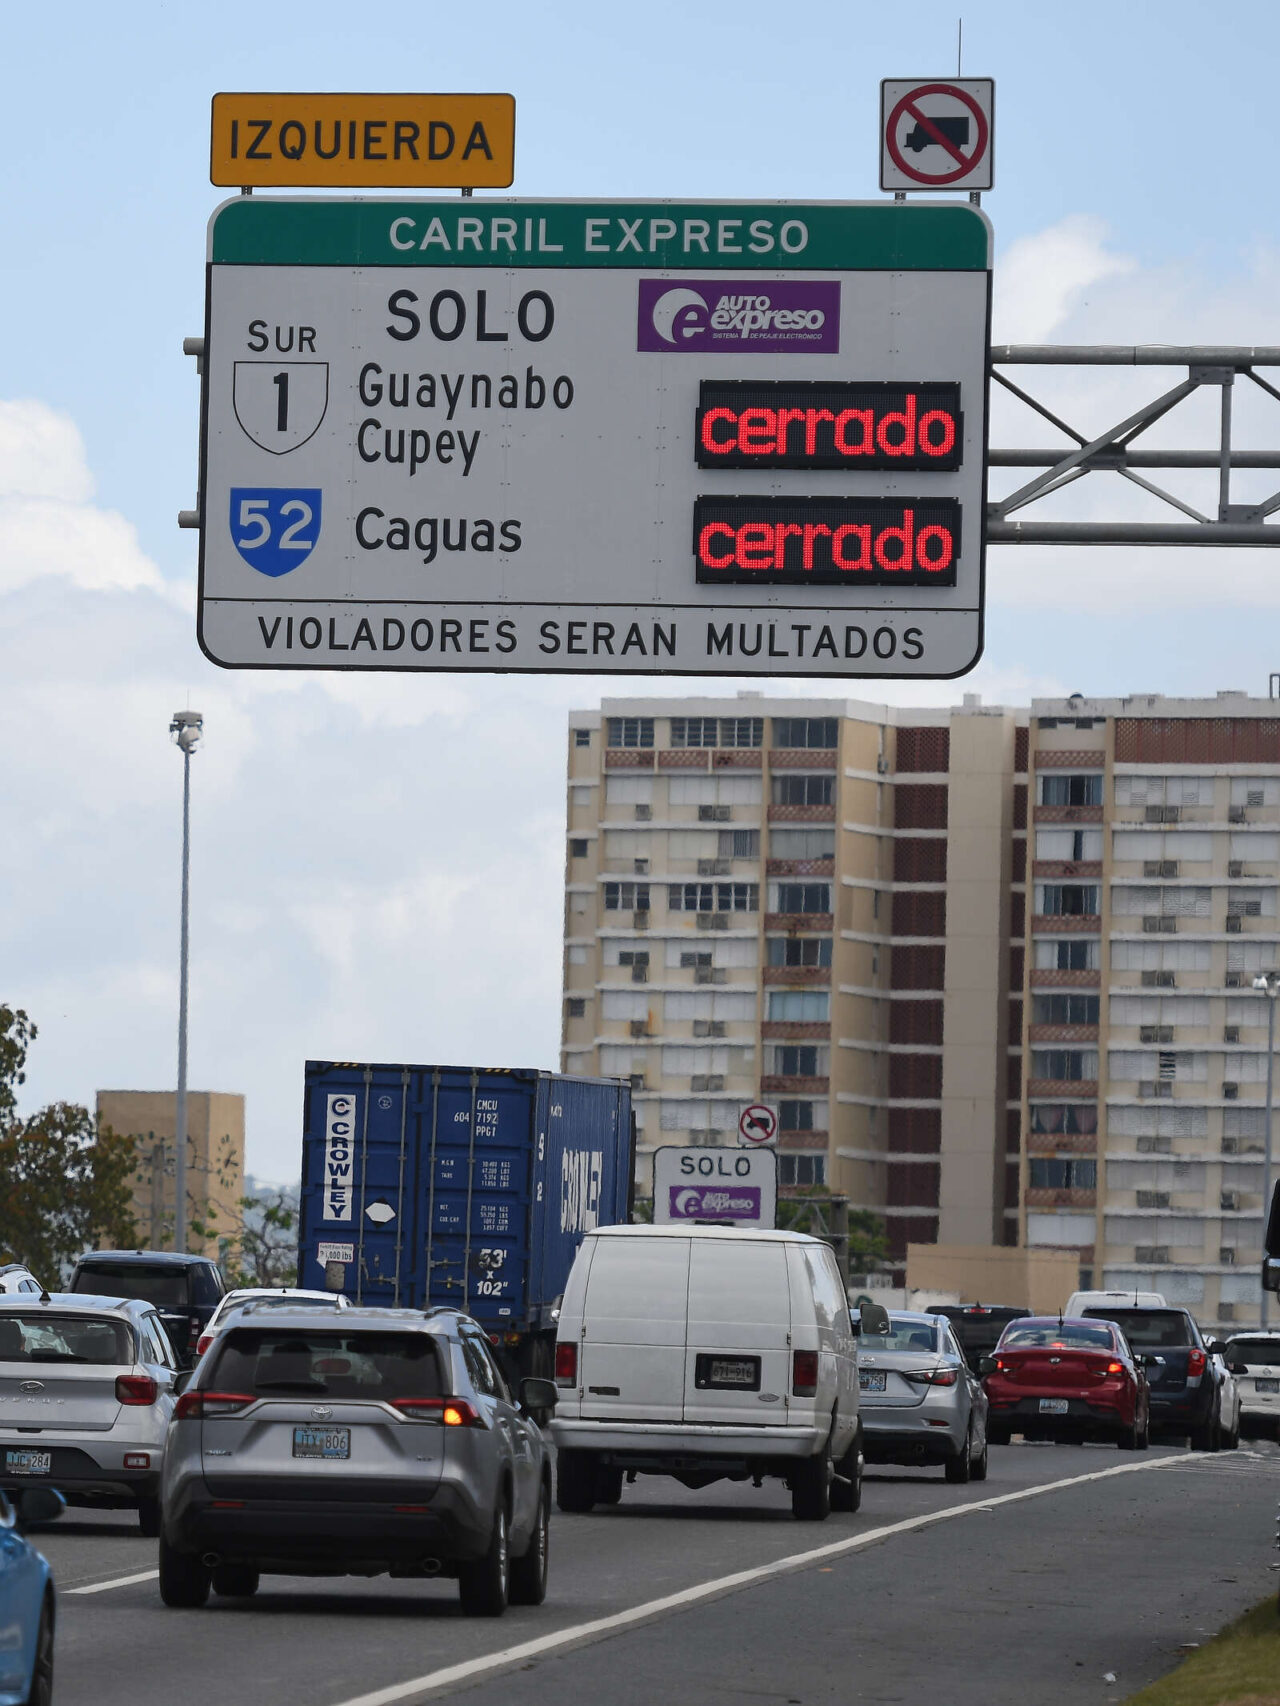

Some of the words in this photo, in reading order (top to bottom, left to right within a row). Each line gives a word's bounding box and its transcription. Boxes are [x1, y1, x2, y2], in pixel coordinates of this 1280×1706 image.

[231, 120, 493, 161] IZQUIERDA
[389, 217, 564, 252] CARRIL
[585, 218, 809, 253] EXPRESO
[387, 290, 555, 342] SOLO
[710, 309, 825, 338] expreso
[716, 295, 771, 310] AUTO
[273, 372, 290, 432] 1
[358, 363, 575, 418] Guaynabo
[701, 394, 956, 457] cerrado
[358, 418, 481, 477] Cupey
[237, 500, 314, 550] 52
[355, 506, 522, 565] Caguas
[699, 509, 953, 571] cerrado
[258, 617, 518, 653] VIOLADORES
[538, 621, 677, 656] SERAN
[706, 624, 925, 660] MULTADOS
[454, 1112, 470, 1122] 604
[476, 1099, 498, 1110] CMCU
[328, 1121, 351, 1218] CROWLEY
[680, 1156, 751, 1177] SOLO
[31, 1455, 49, 1468] 284
[325, 1434, 347, 1450] 806
